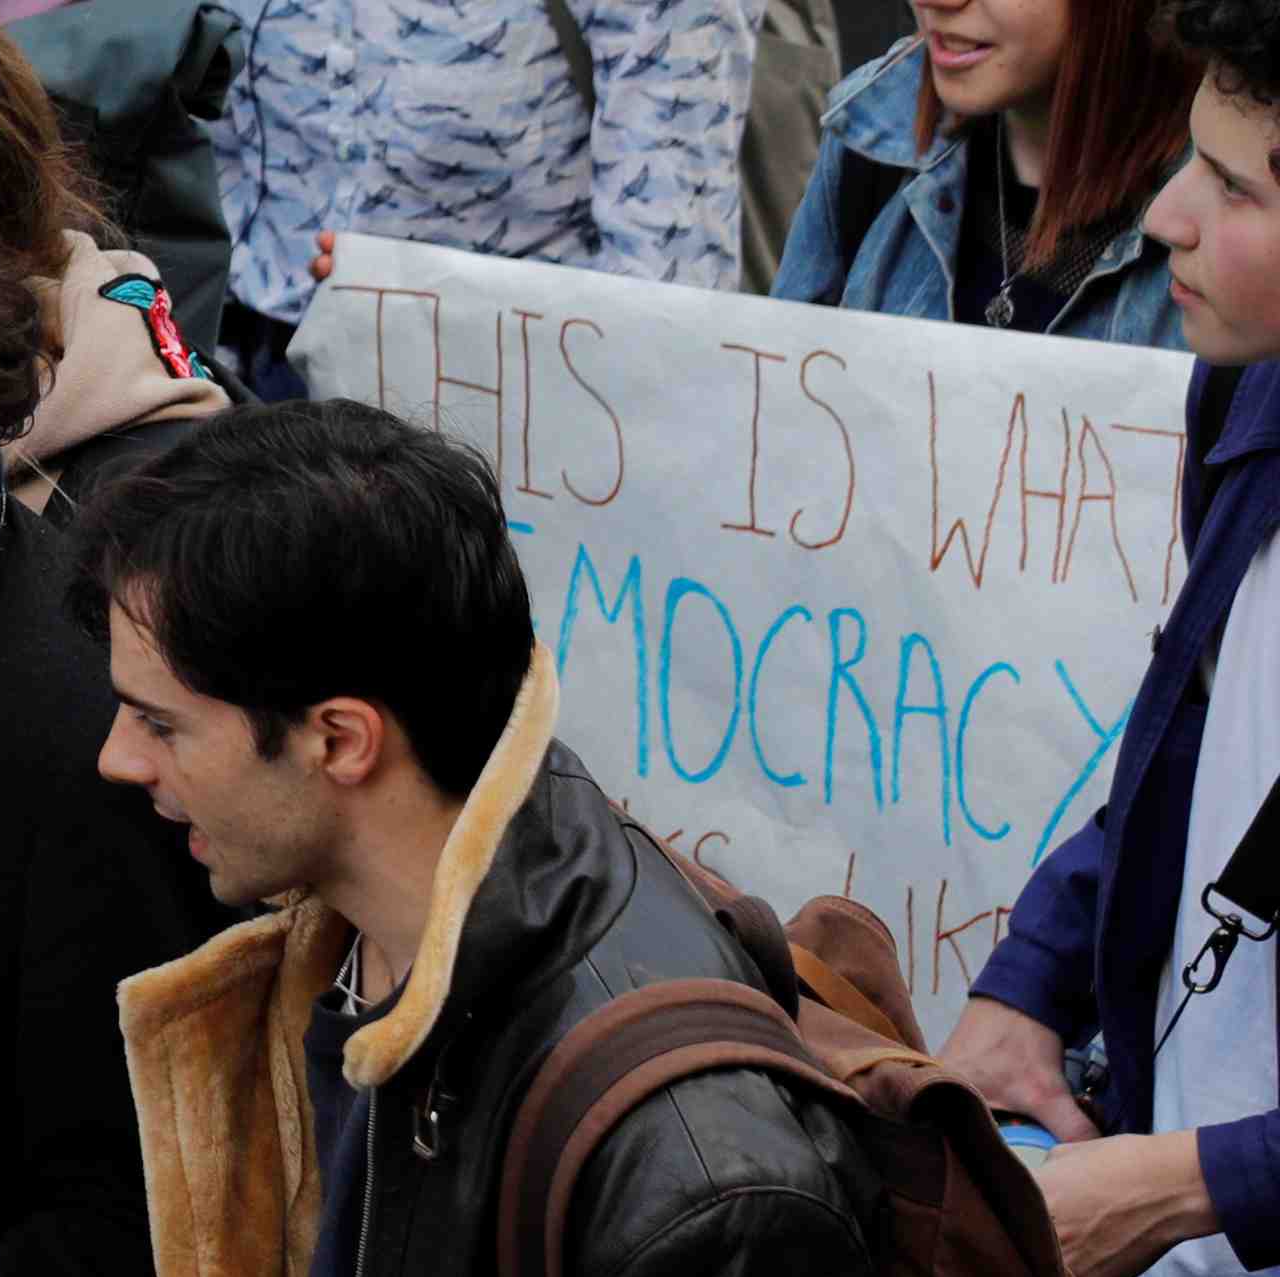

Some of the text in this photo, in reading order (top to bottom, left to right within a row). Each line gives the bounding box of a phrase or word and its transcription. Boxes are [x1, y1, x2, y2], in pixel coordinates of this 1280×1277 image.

[331, 285, 1187, 604] THIS IS WHAT
[507, 520, 1138, 868] MOCRACY
